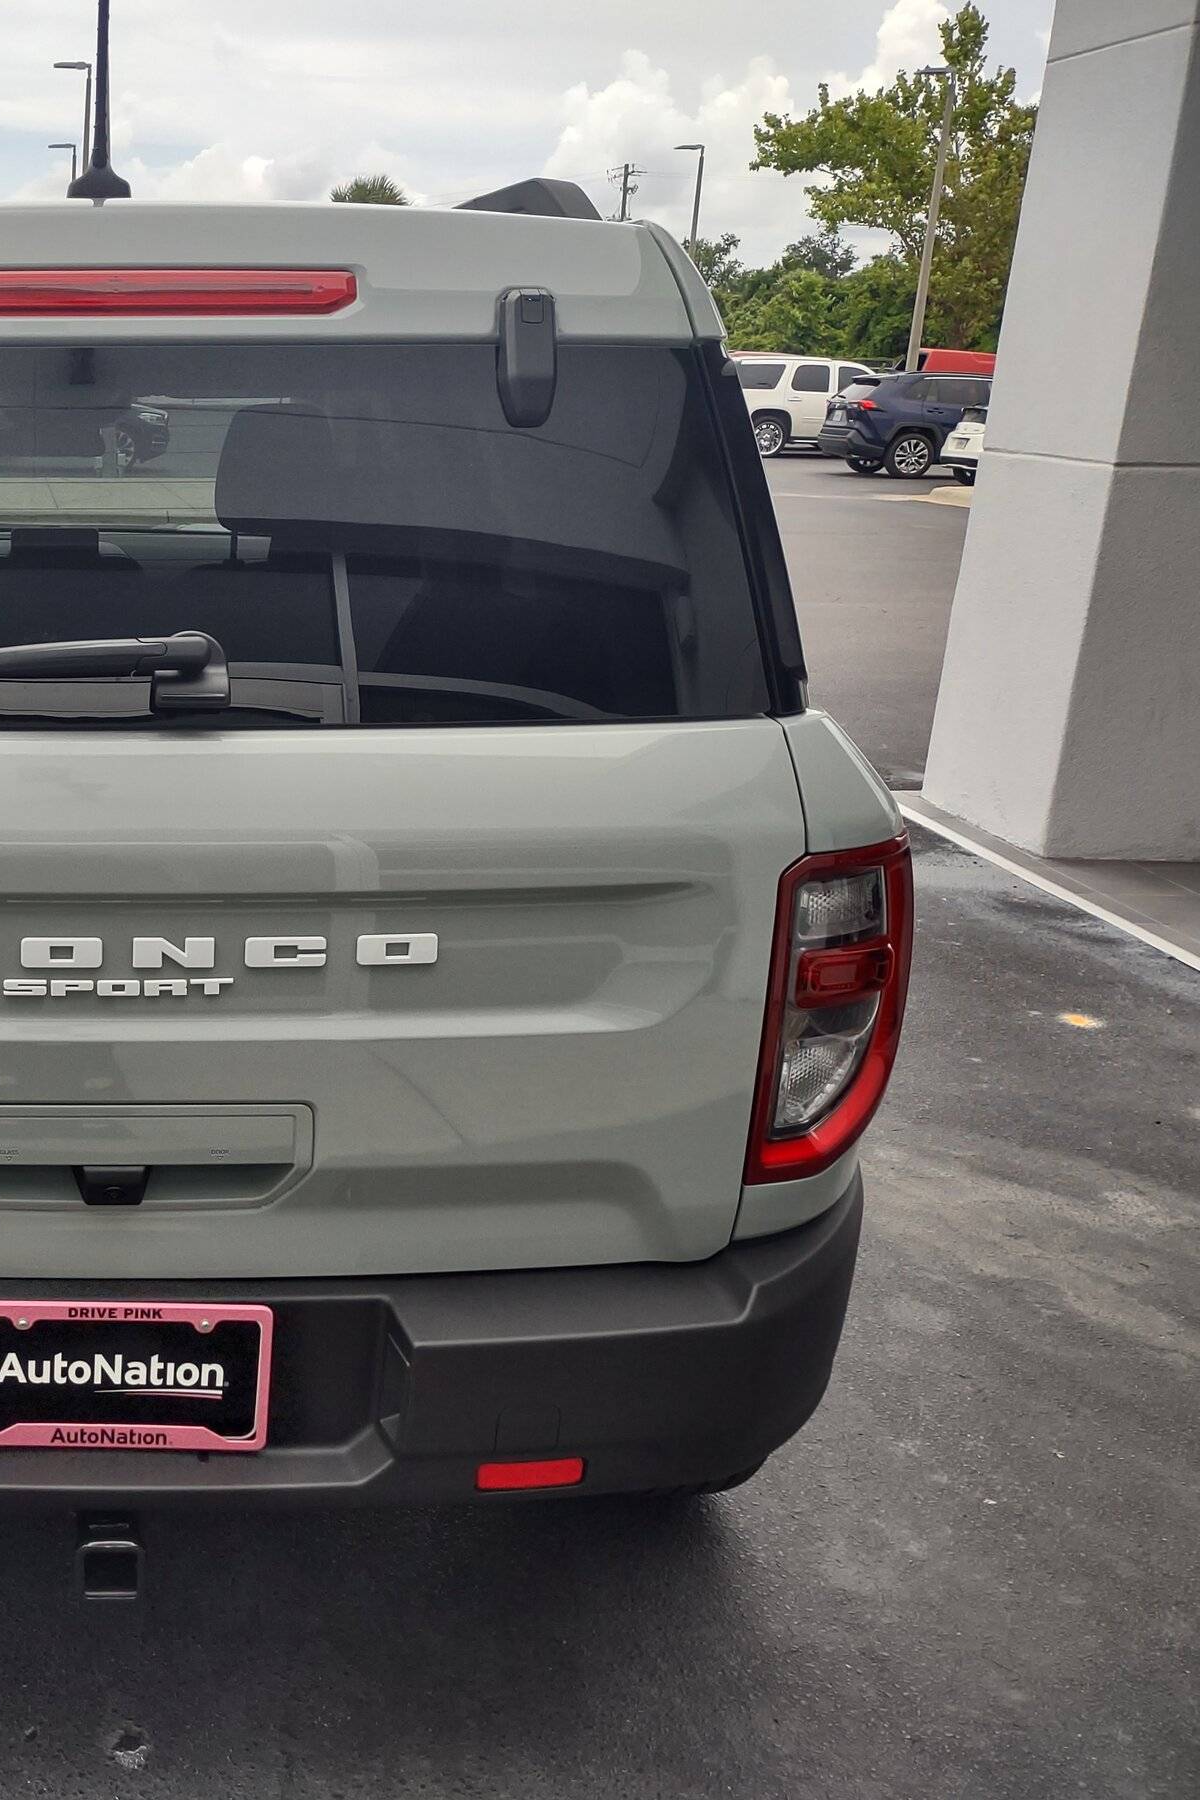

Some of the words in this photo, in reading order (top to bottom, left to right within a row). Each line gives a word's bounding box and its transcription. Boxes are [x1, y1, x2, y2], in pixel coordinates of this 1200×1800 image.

[2, 977, 235, 997] SPORT
[67, 1307, 118, 1319] DRIVE
[123, 1307, 164, 1320] PINK
[50, 1427, 168, 1446] AutoNation
